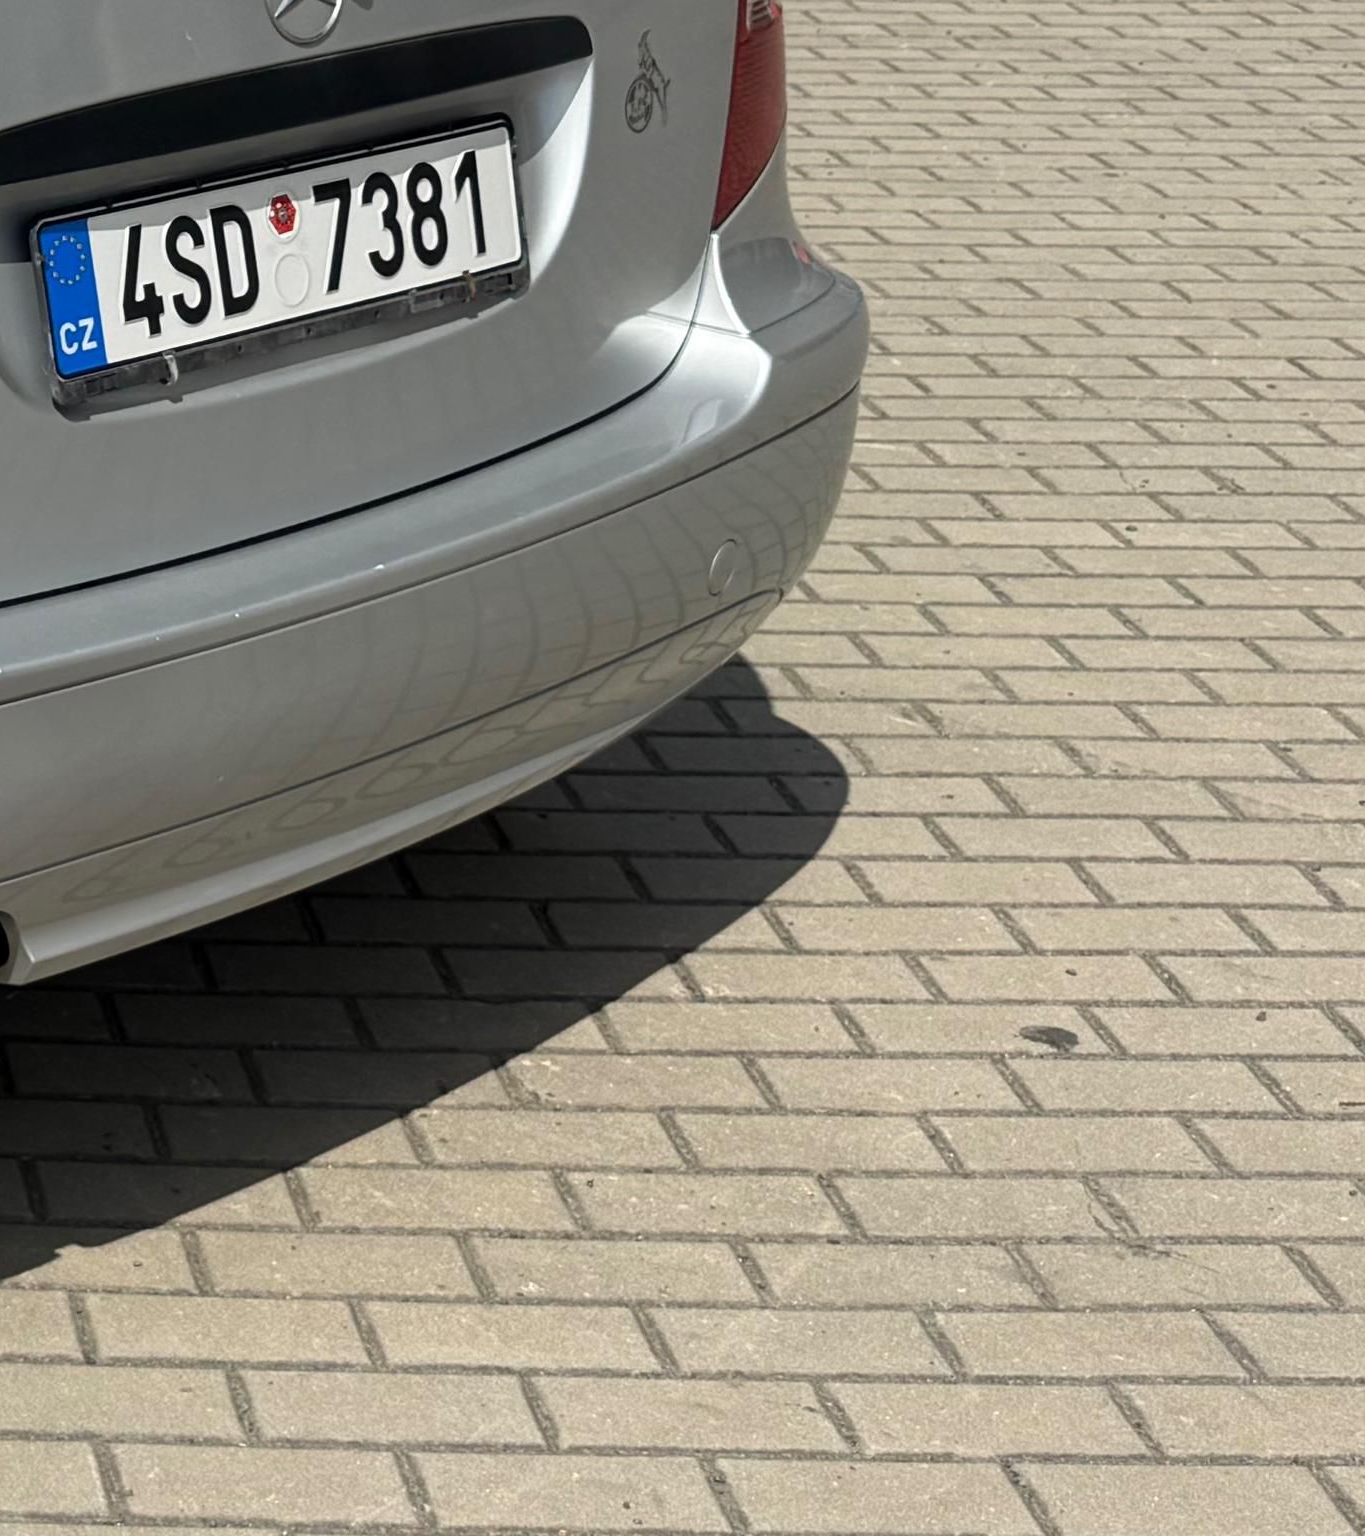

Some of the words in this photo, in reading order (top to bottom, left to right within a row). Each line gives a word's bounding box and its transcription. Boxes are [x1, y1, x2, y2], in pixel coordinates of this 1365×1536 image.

[122, 204, 260, 337] 4SD
[311, 149, 488, 295] 7381
[59, 317, 99, 355] CZ
